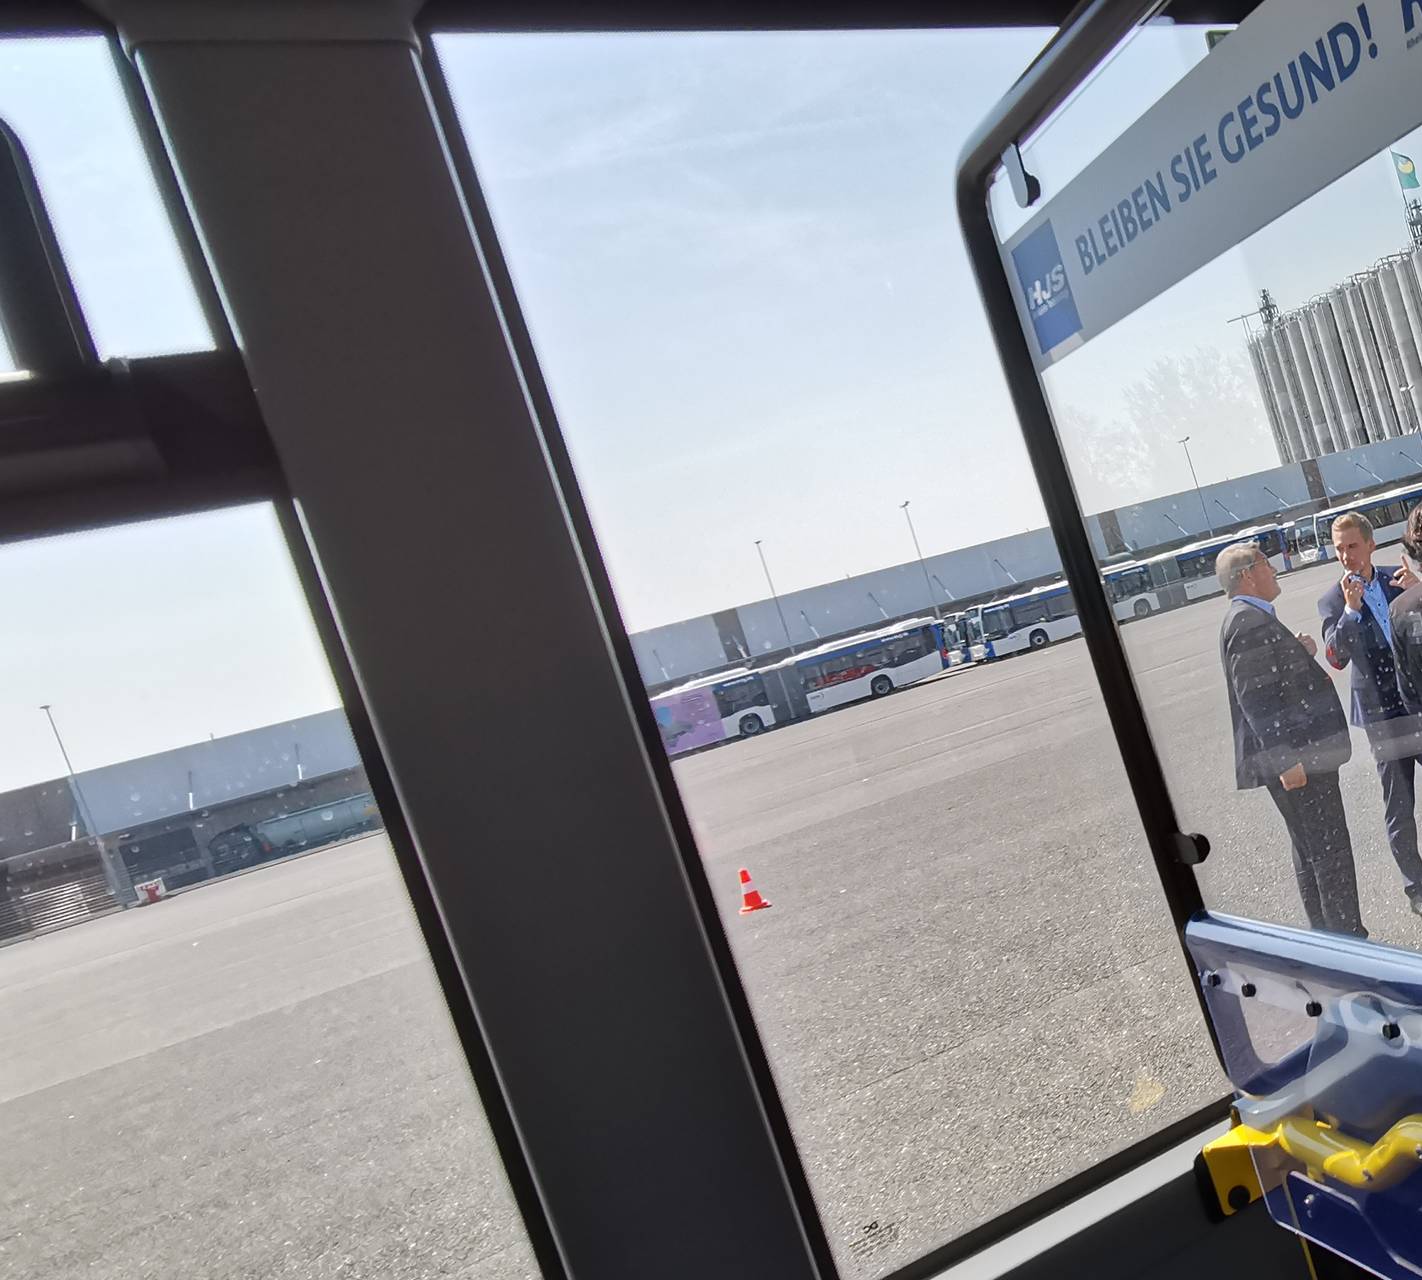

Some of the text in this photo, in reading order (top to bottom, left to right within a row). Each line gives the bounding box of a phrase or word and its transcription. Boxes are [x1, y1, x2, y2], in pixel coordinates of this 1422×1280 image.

[1075, 2, 1378, 275] BLEIBEN SIE GESUND!
[1027, 264, 1065, 311] HJS
